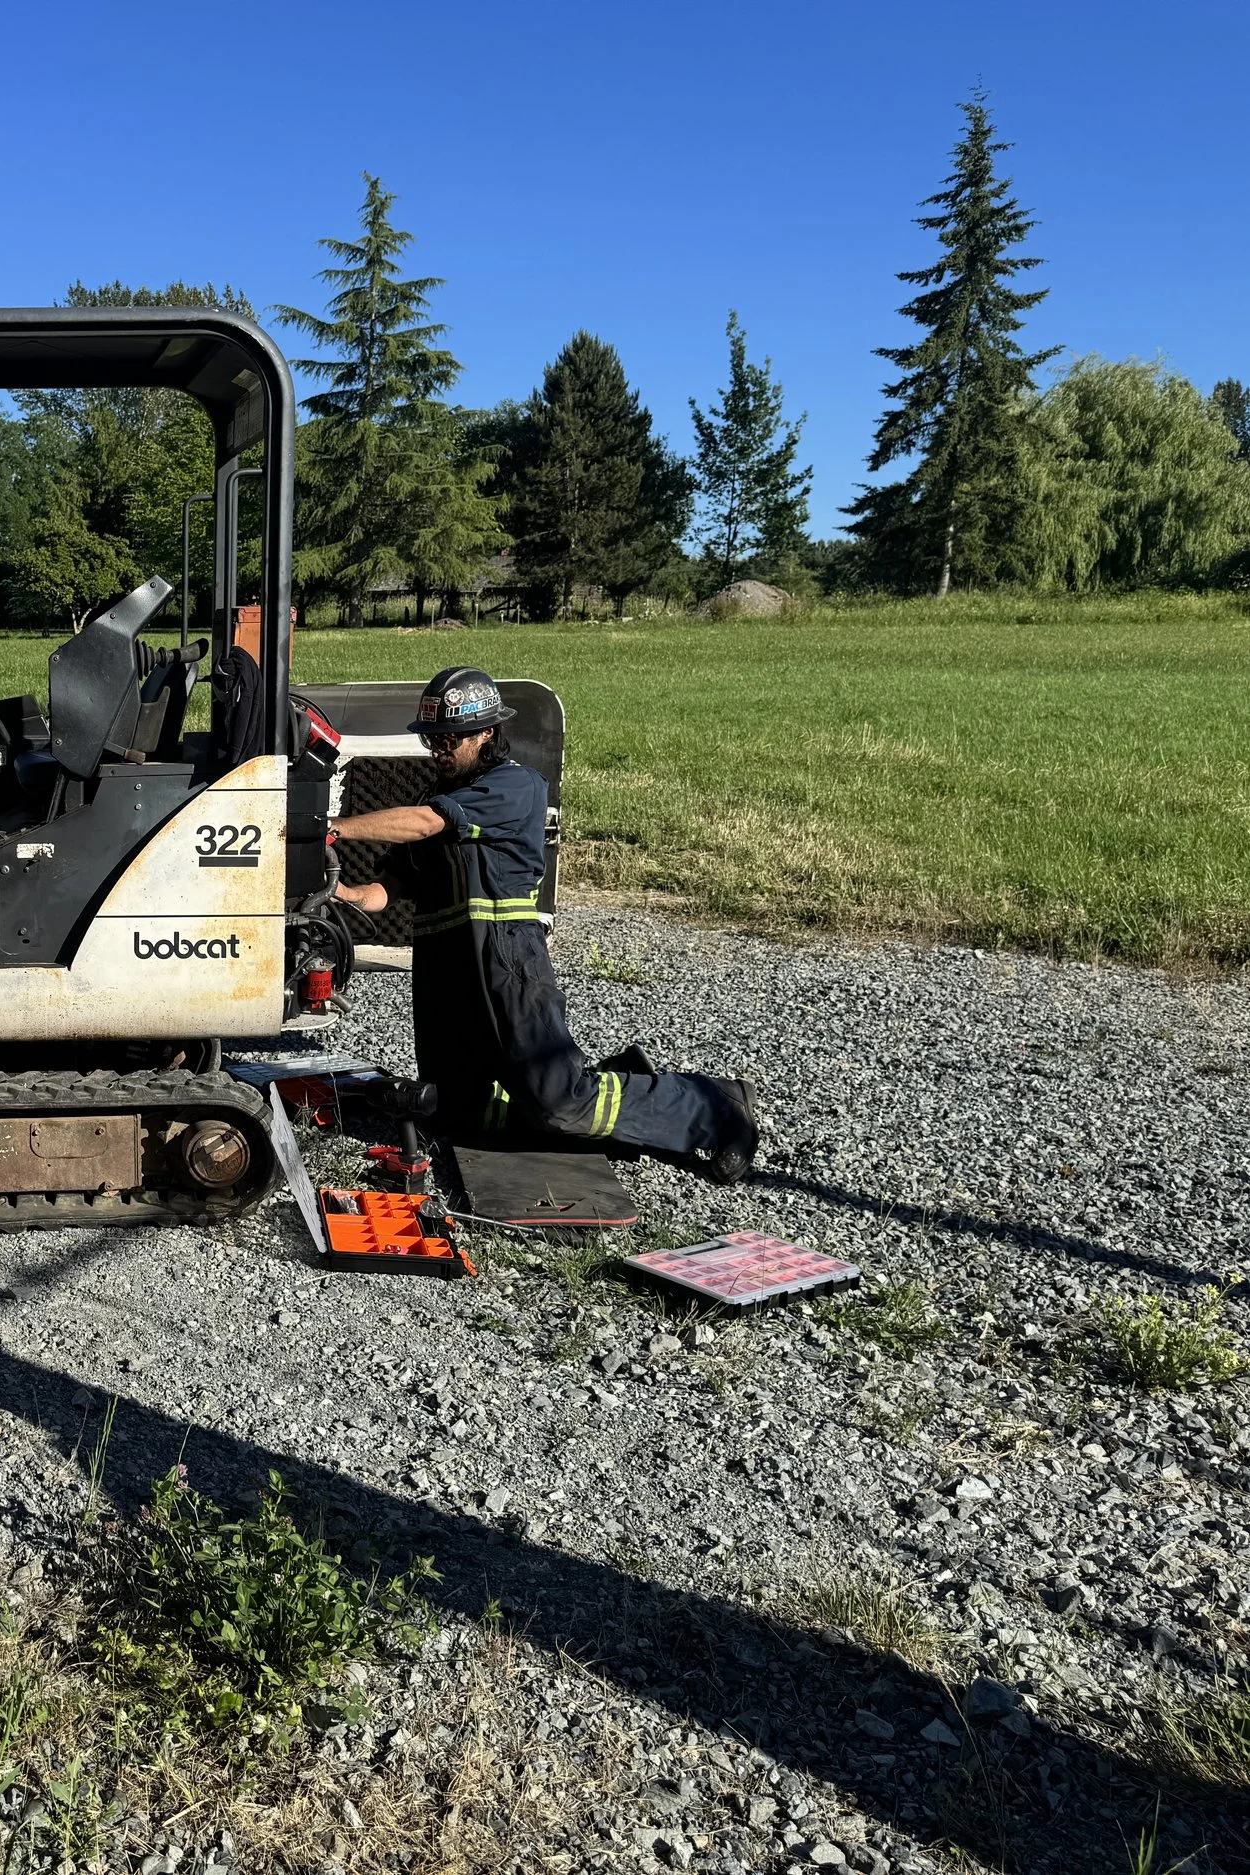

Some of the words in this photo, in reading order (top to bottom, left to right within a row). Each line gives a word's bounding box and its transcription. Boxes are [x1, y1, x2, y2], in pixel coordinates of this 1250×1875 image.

[461, 694, 501, 714] PACBRAK
[195, 825, 262, 855] 322
[134, 931, 240, 960] bobcat
